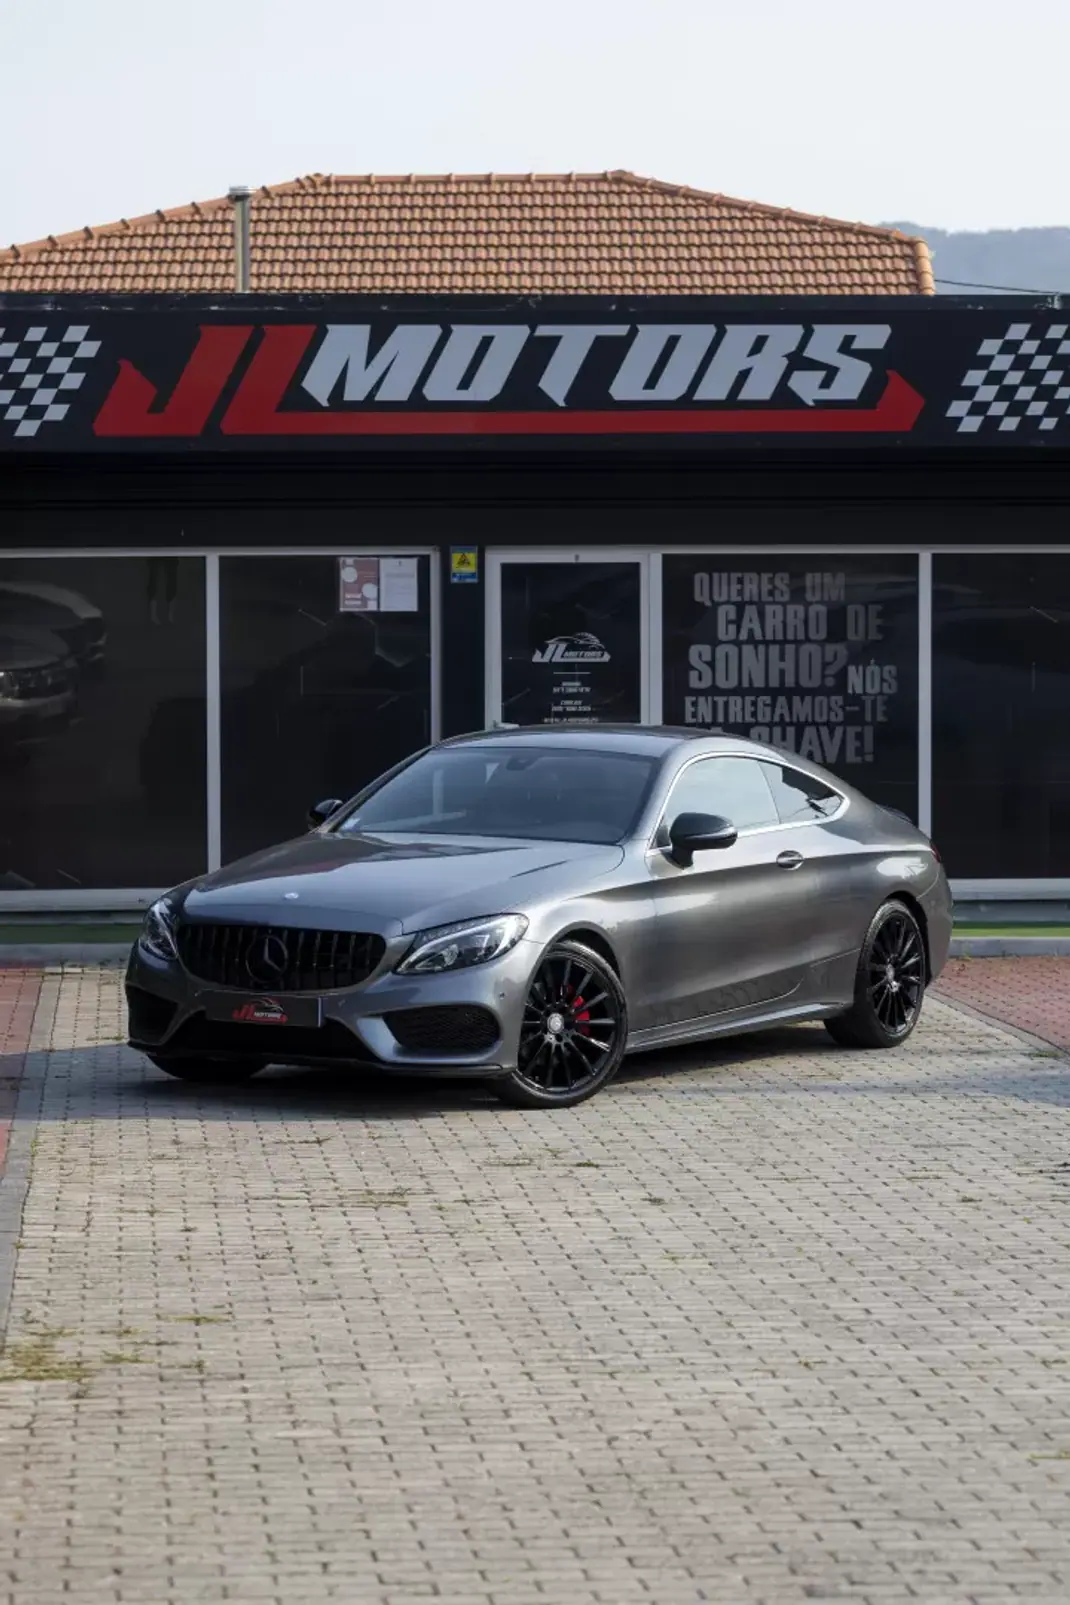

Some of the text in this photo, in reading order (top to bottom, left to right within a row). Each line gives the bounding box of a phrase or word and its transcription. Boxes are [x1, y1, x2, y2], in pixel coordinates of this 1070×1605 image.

[92, 324, 892, 436] JL MOTORS
[694, 572, 846, 606] QUERES UM
[717, 604, 884, 641] CARRO DE
[688, 643, 898, 694] SONHO? NÓS
[684, 696, 889, 723] ENTREGAMOS-TE
